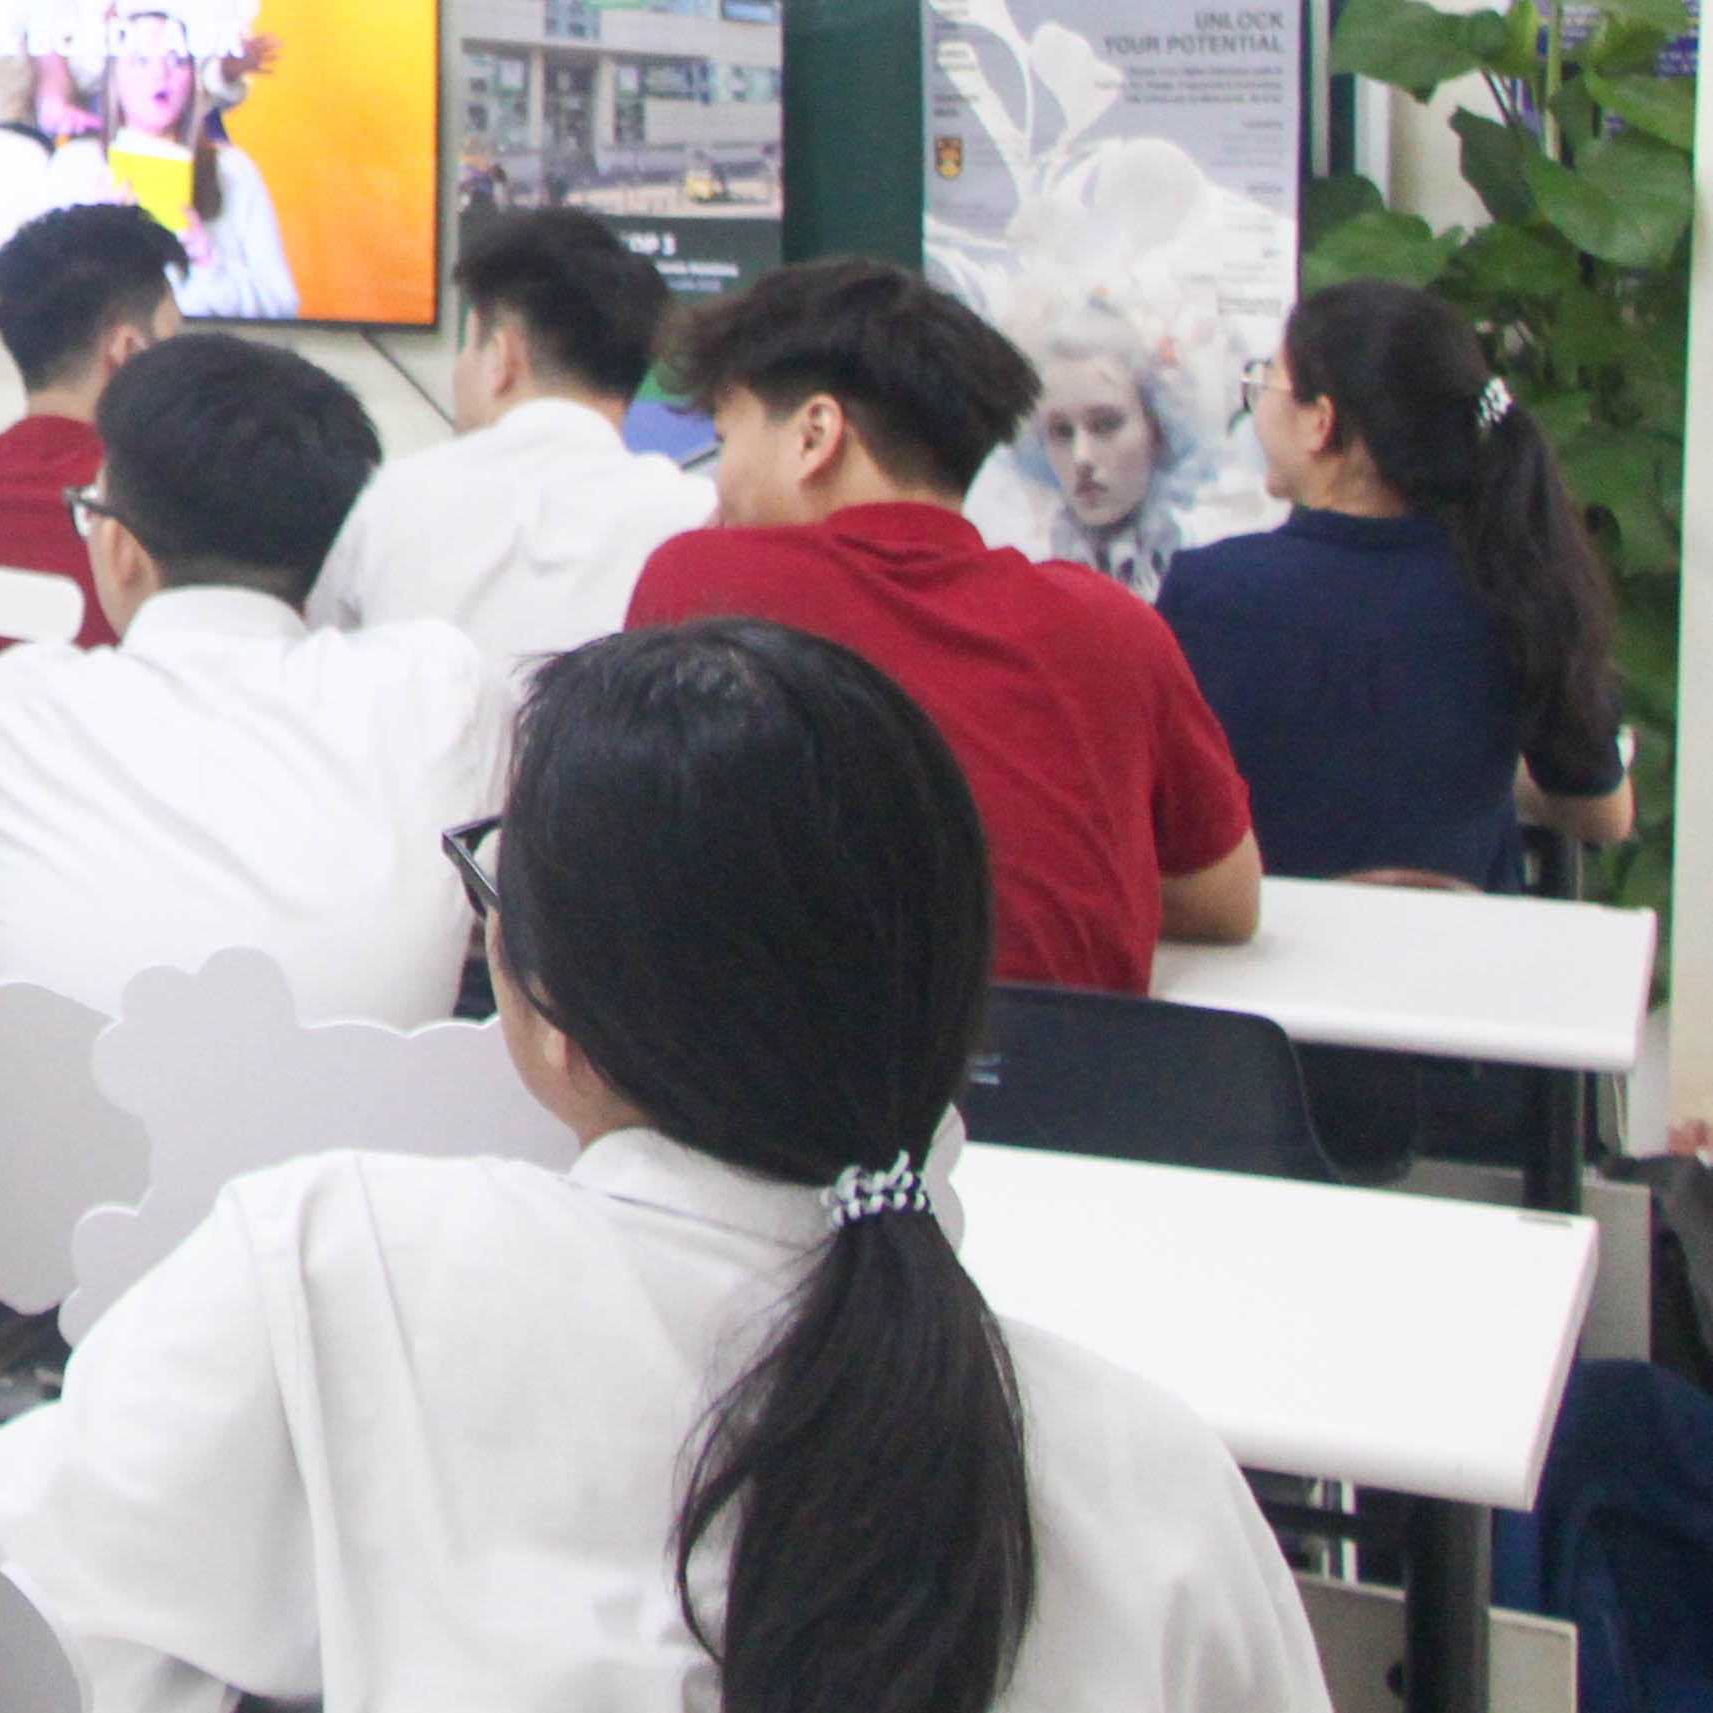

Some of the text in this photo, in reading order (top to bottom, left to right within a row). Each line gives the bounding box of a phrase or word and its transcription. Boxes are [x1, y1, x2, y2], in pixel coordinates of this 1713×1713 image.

[1194, 10, 1283, 30] UNLOCK
[1104, 34, 1283, 55] YOUR POTENTIAL
